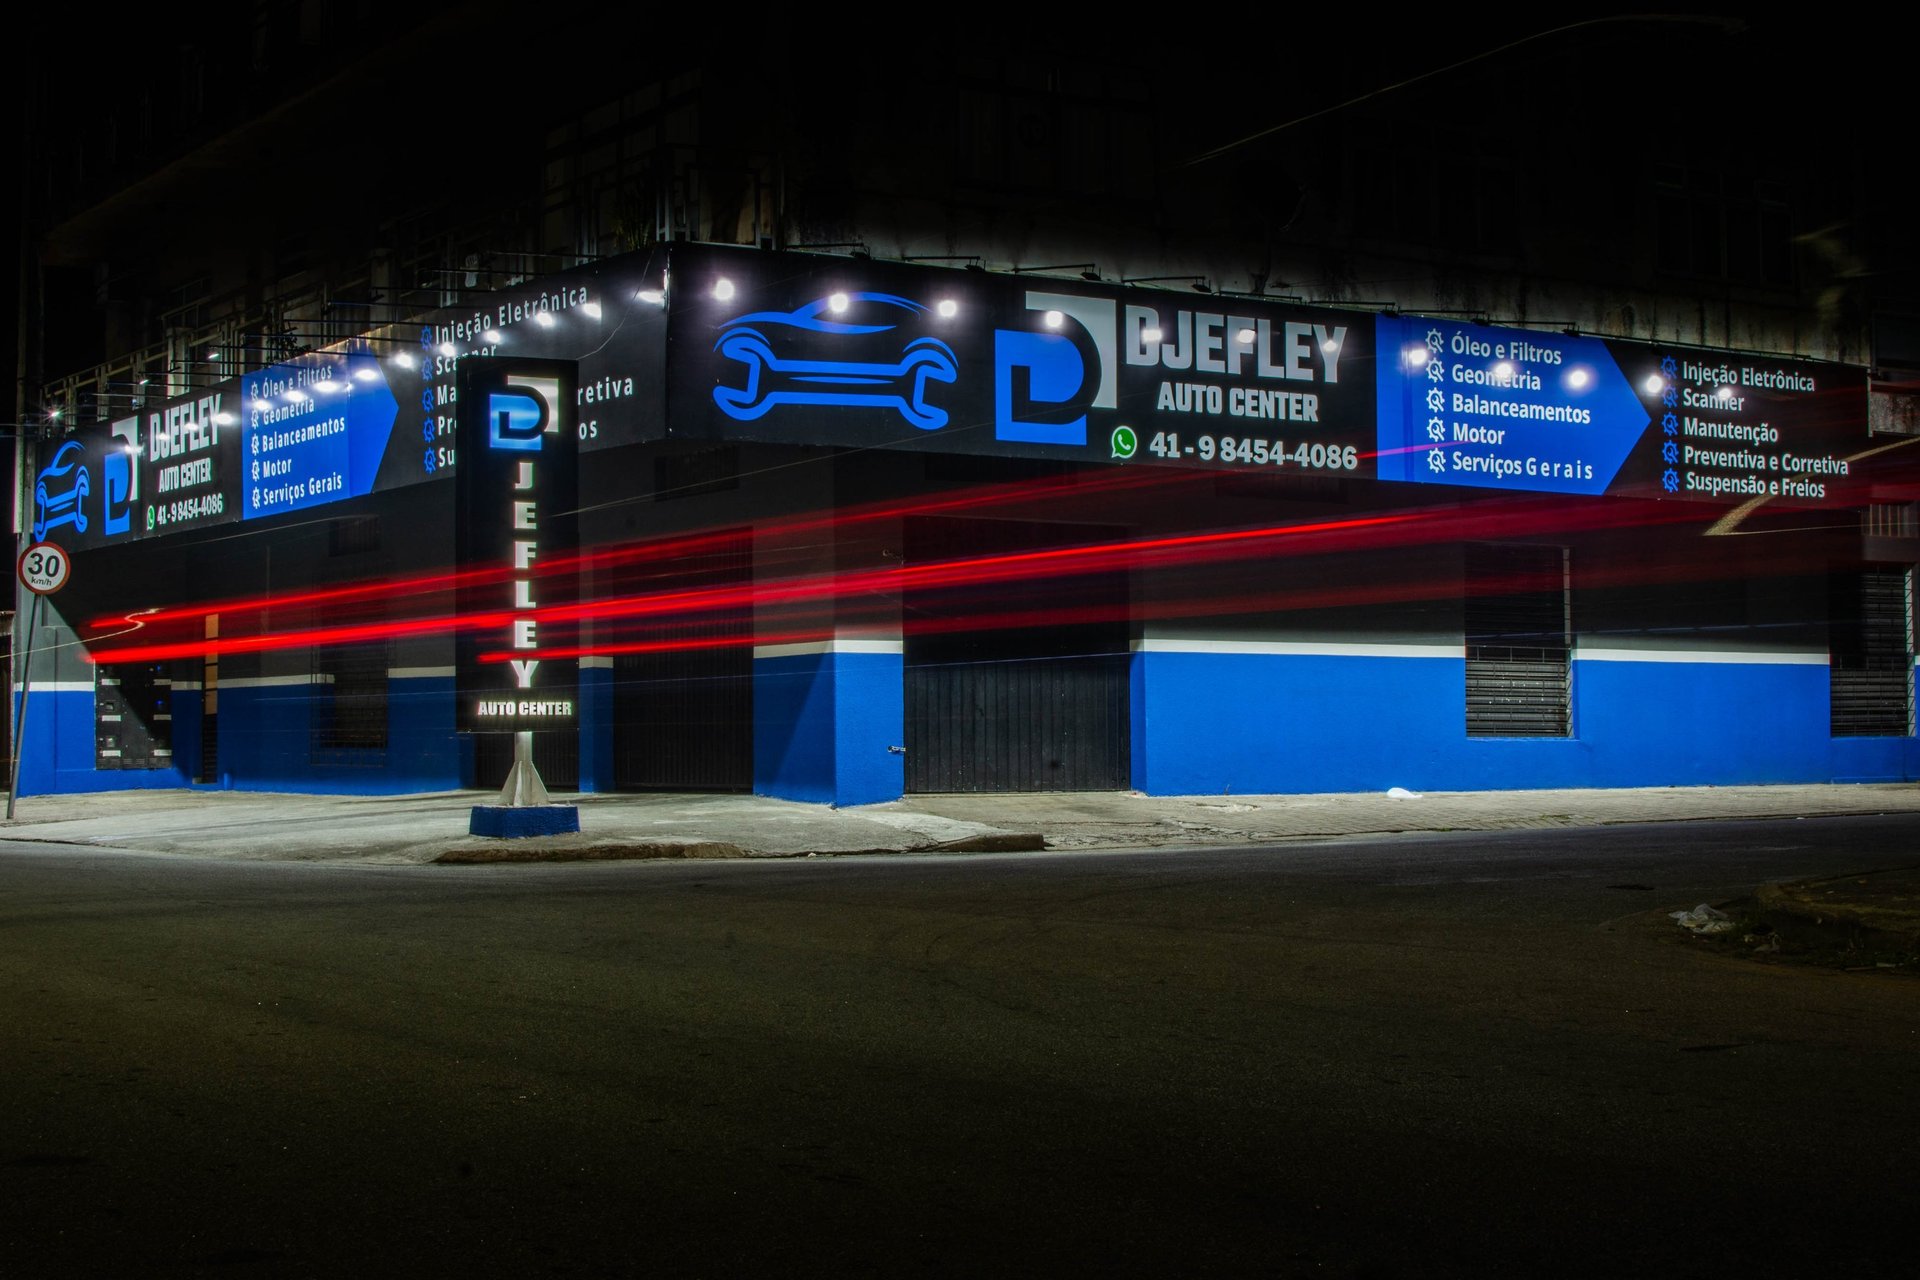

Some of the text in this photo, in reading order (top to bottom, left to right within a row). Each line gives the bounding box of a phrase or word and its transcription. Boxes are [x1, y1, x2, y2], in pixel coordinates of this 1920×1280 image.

[435, 286, 587, 345] Injeção Eletrônica
[1125, 304, 1348, 383] DJEFLEY
[1451, 330, 1562, 365] Óleo e Filtros
[262, 365, 332, 399] Óleo e Filtros
[1452, 364, 1541, 390] Geometria
[1683, 361, 1815, 392] Injeção Eletrônica
[262, 398, 315, 425] Geometria
[1157, 381, 1319, 422] AUTO CENTER
[1453, 393, 1591, 424] Balanceamentos
[1683, 388, 1744, 411] Scanner
[150, 393, 222, 462] DJEFLEY
[262, 416, 345, 453] Balanceamentos
[1453, 422, 1505, 445] Motor
[1684, 417, 1778, 446] Manutenção
[158, 457, 212, 493] AUTO CENTER
[262, 458, 292, 478] Motor
[1452, 451, 1593, 479] Serviços Gerais
[1685, 445, 1849, 475] Preventiva e Corretiva
[263, 472, 342, 505] Serviços Gerais
[1686, 471, 1825, 498] Suspensão e Freios
[28, 553, 60, 578] 30
[31, 577, 52, 587] km/h
[478, 701, 572, 716] AUTO CENTER
